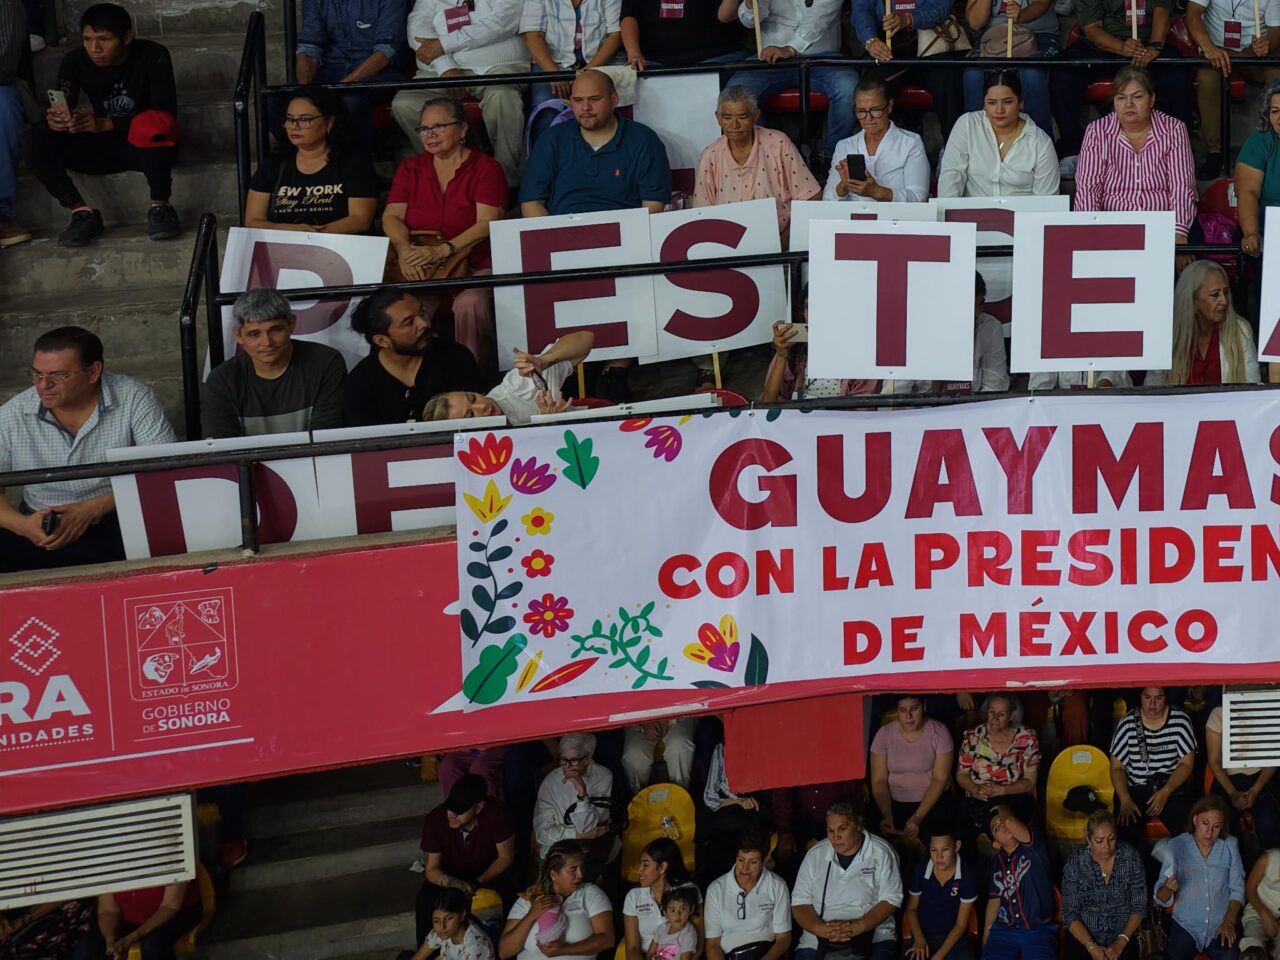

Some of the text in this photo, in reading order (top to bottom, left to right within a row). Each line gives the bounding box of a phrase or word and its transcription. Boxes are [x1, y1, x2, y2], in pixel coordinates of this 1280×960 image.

[278, 183, 344, 197] EW YORK
[835, 224, 1146, 367] TE
[658, 548, 794, 600] CON
[822, 542, 894, 591] LA
[843, 596, 1218, 666] DE MÉXICO
[142, 687, 179, 698] ESTADO
[191, 681, 229, 692] SONORA
[142, 698, 231, 721] GOBIERNO
[143, 711, 230, 734] DE SONORA
